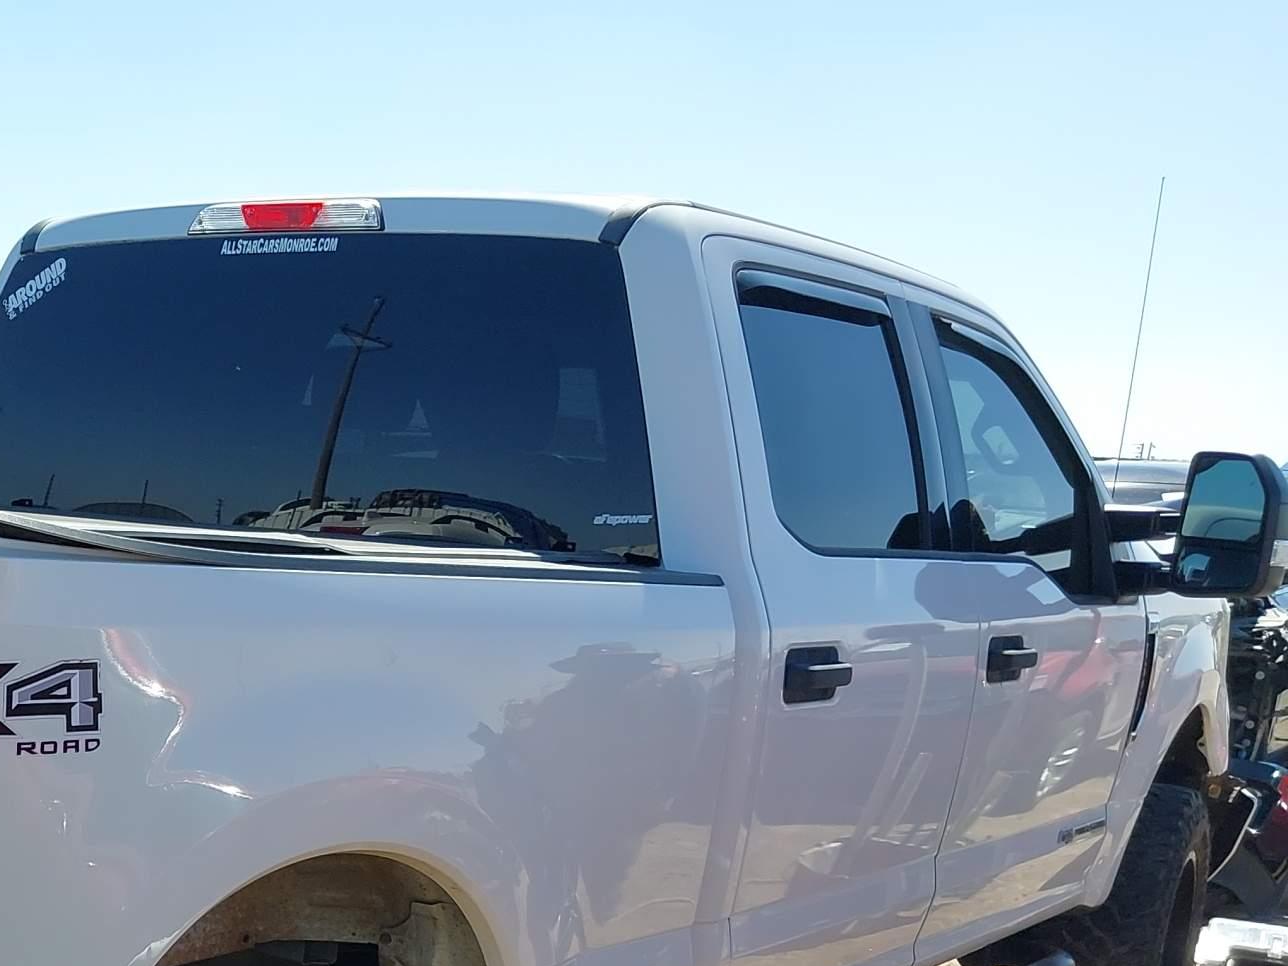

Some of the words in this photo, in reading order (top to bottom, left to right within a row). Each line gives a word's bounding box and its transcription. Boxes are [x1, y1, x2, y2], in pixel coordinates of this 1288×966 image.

[8, 257, 67, 312] AROUND
[45, 272, 66, 292] OUT
[16, 739, 101, 756] ROAD
